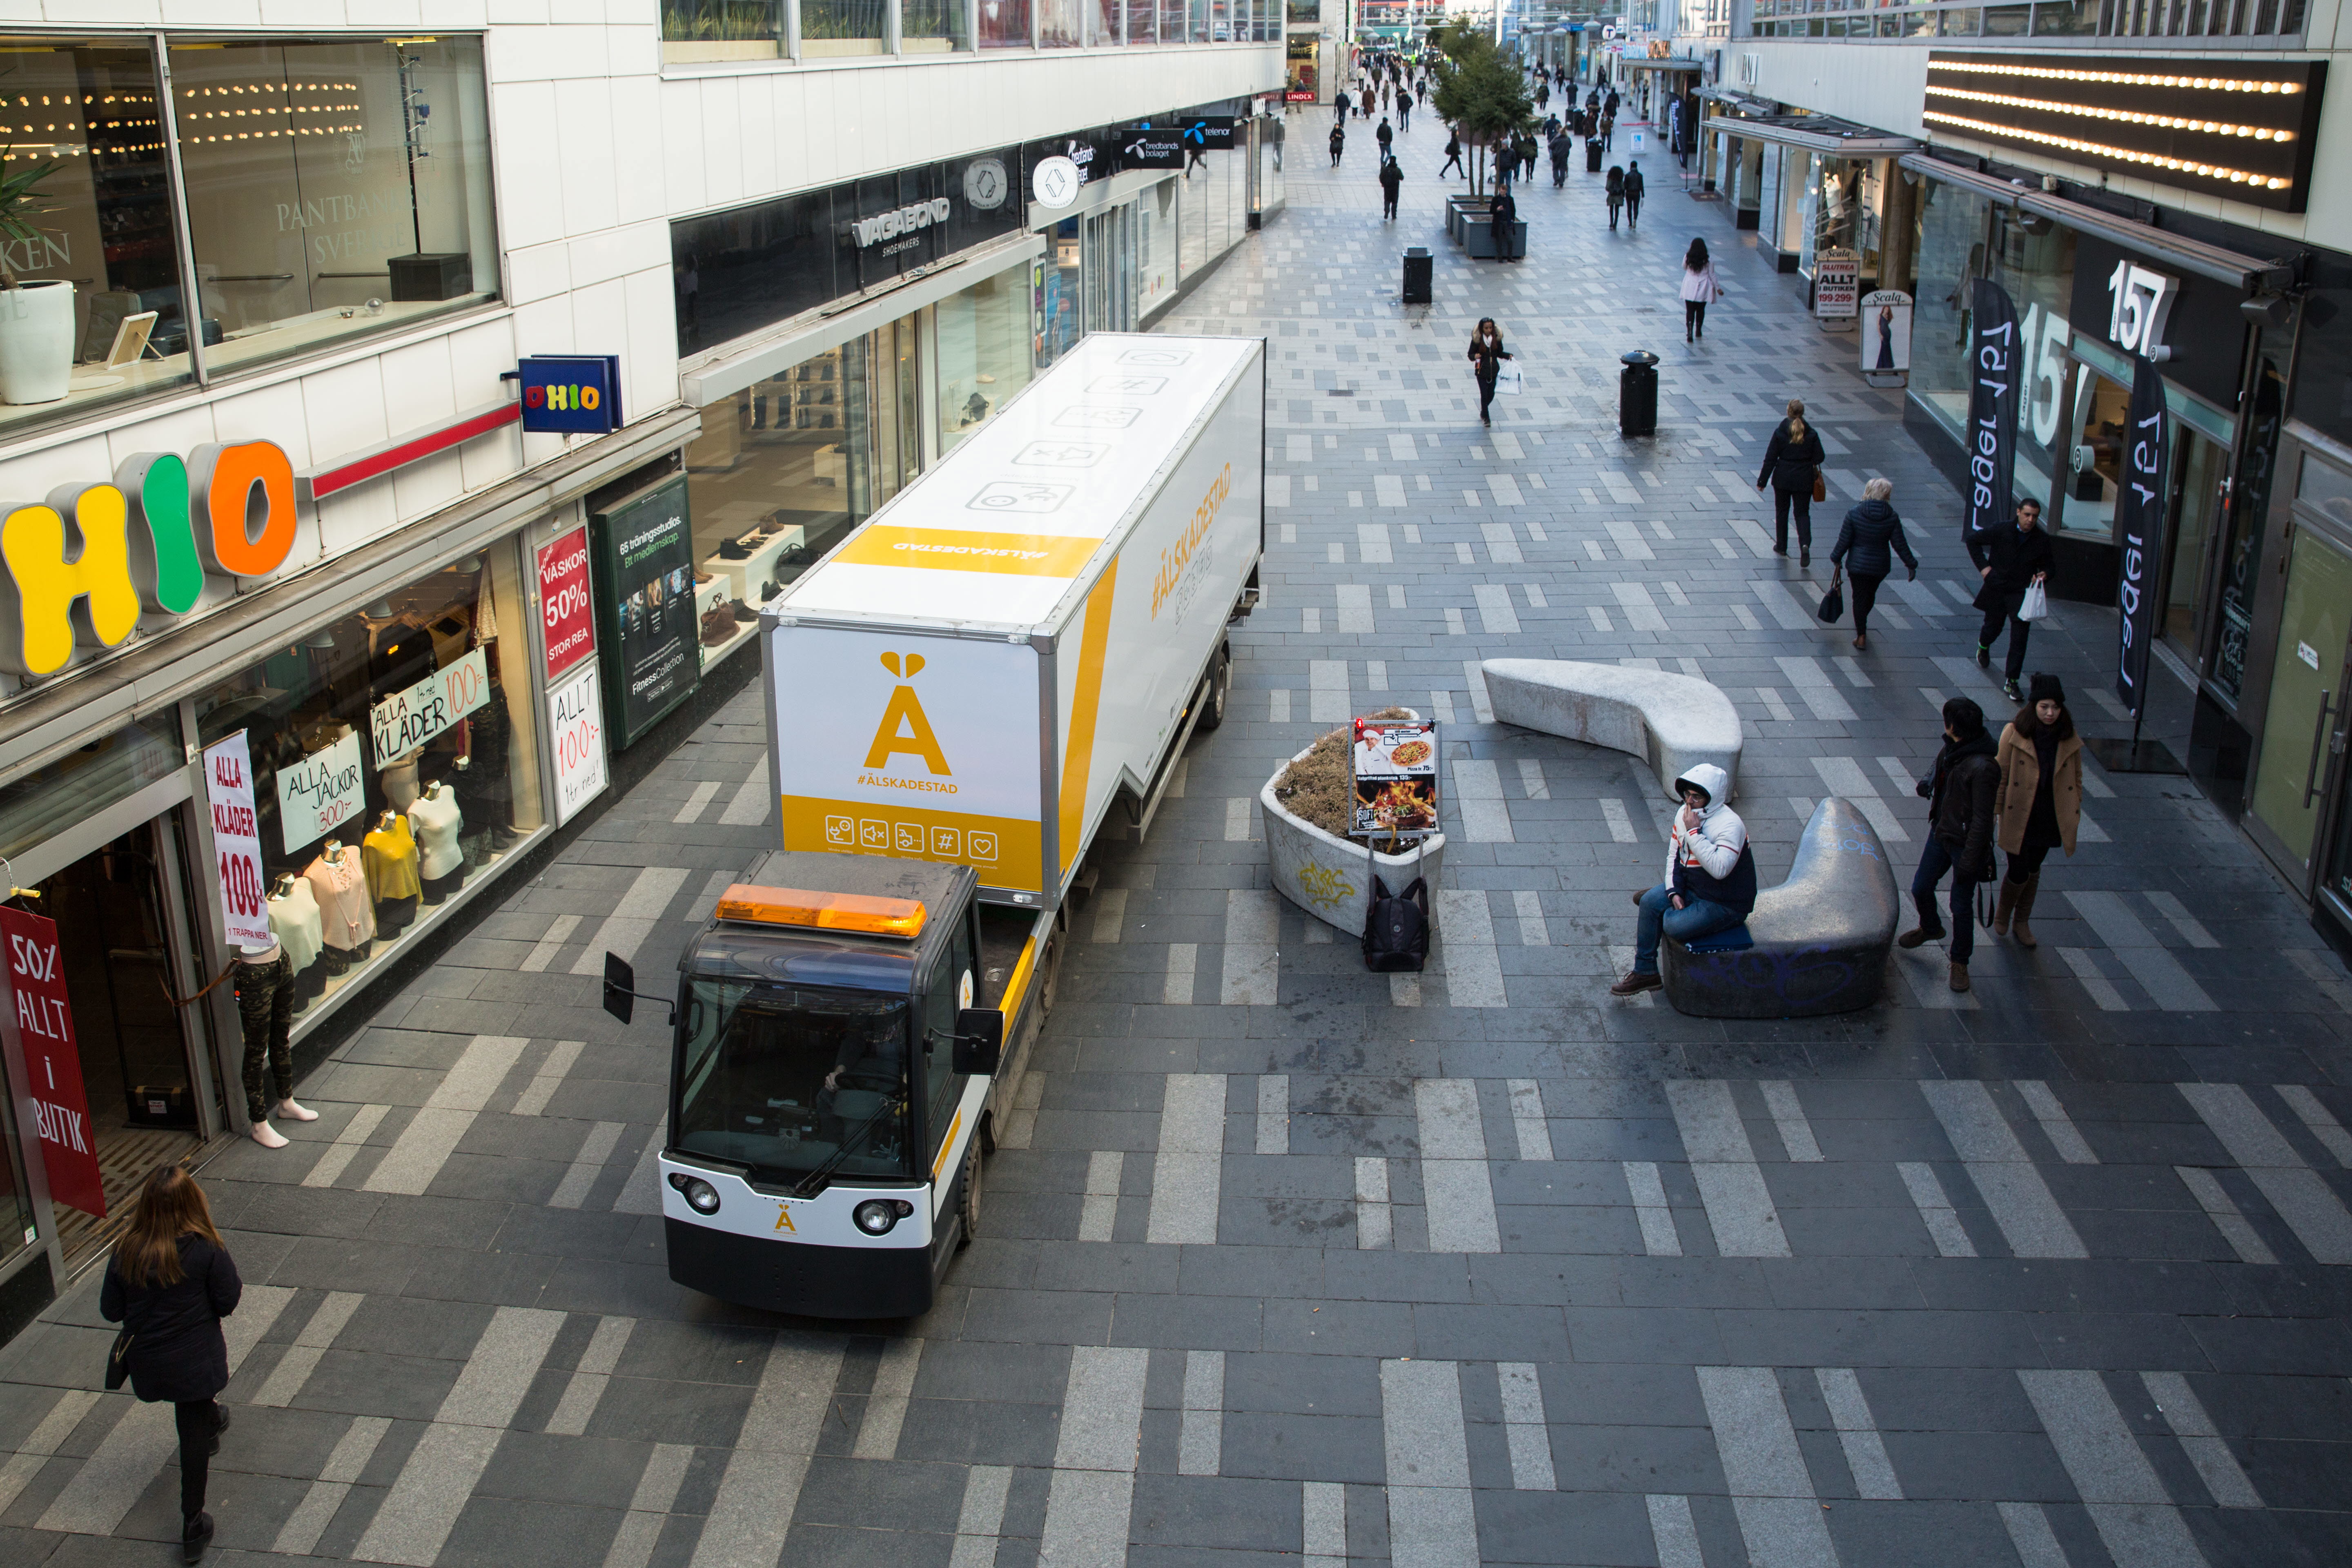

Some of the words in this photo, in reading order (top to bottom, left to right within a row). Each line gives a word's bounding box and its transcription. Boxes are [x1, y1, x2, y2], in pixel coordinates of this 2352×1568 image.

[1146, 142, 1178, 150] bredbands
[1205, 128, 1230, 136] telenor
[1146, 150, 1169, 158] bolaget
[276, 182, 430, 232] PANTBANKEN
[1041, 198, 1071, 207] SHOEMAKERS
[852, 198, 950, 247] VAGABOND
[314, 222, 405, 264] SVERIGE
[882, 237, 919, 257] SHOEMAKERS
[1820, 275, 1856, 284] ALLT
[1874, 292, 1902, 303] Scala
[2109, 259, 2167, 356] 157
[526, 384, 599, 410] OHIO
[2020, 383, 2028, 422] Lager
[620, 541, 629, 555] 65
[629, 516, 682, 550] träningsstudios.
[625, 556, 633, 568] Ett
[634, 532, 679, 563] medlemskap.
[893, 542, 1048, 560] #ÄLSKADESTAD
[1152, 462, 1231, 622] #ÄLSKADESTAD
[538, 543, 554, 576] MODE
[543, 548, 587, 584] VÄSKOR
[546, 579, 587, 628] 50%
[549, 638, 570, 661] STOR
[571, 628, 588, 646] REA
[633, 653, 684, 695] FitnessCollection
[374, 697, 406, 732] ALLA
[556, 673, 593, 731] ALLT
[374, 697, 447, 765] KLÄDER
[559, 720, 599, 777] 100:-
[216, 755, 242, 789] ALLA
[287, 762, 330, 800] ALLA
[312, 765, 359, 809] JACKOR
[857, 773, 958, 794] #ÄLSKADESTAD
[213, 799, 256, 838] KLÄDER
[1359, 809, 1374, 821] SOFT
[233, 928, 254, 938] TRAPPA
[255, 931, 267, 940] NER
[11, 934, 56, 982] 50%
[17, 989, 68, 1042] ALLT
[33, 1098, 88, 1155] BUTIK
